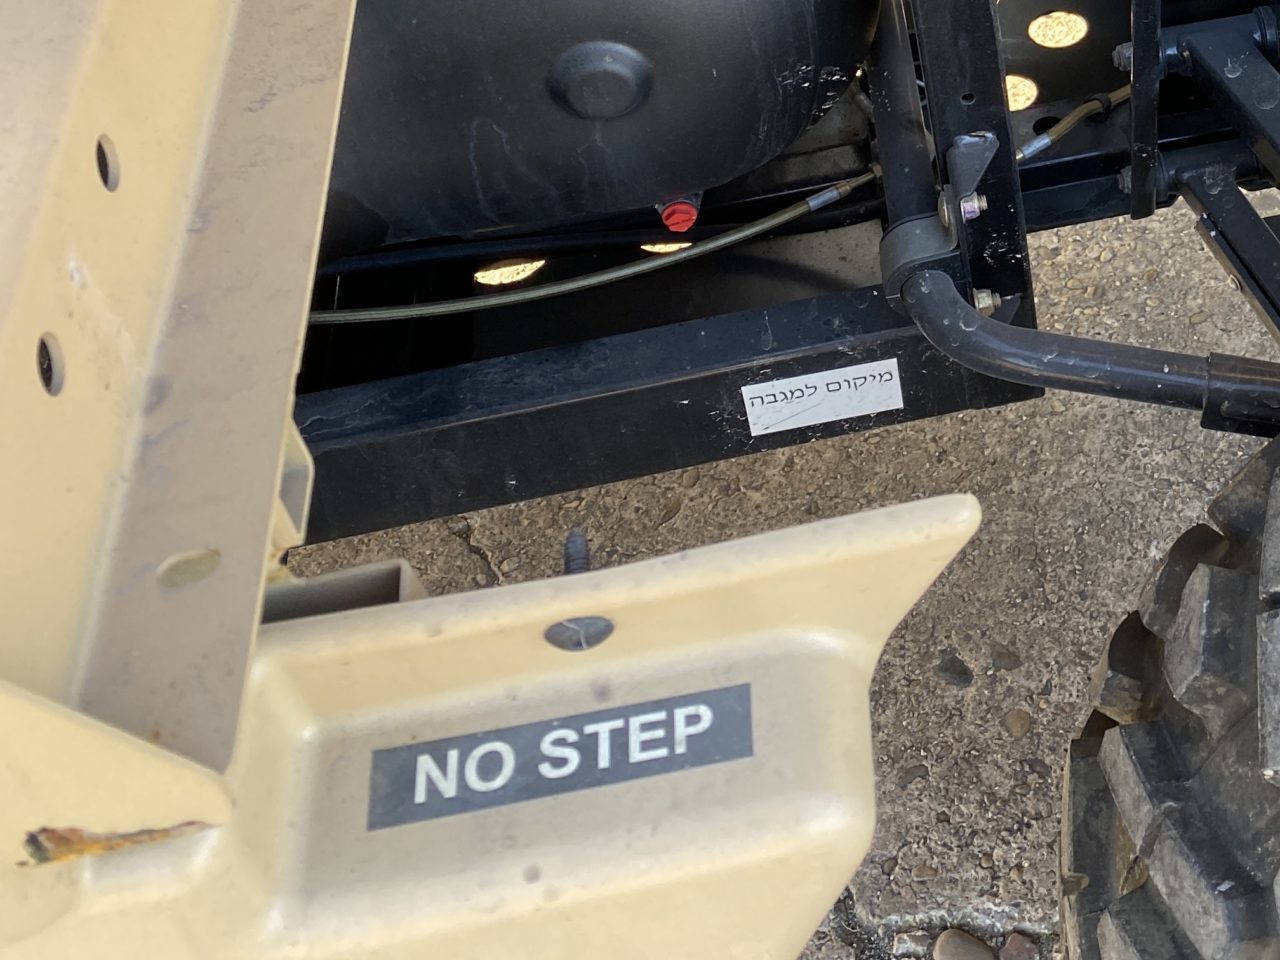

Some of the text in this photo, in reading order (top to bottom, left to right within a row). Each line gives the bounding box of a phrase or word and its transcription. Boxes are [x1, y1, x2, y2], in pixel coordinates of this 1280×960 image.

[749, 370, 893, 408] מיקום למגבה
[413, 703, 714, 804] NO STEP
